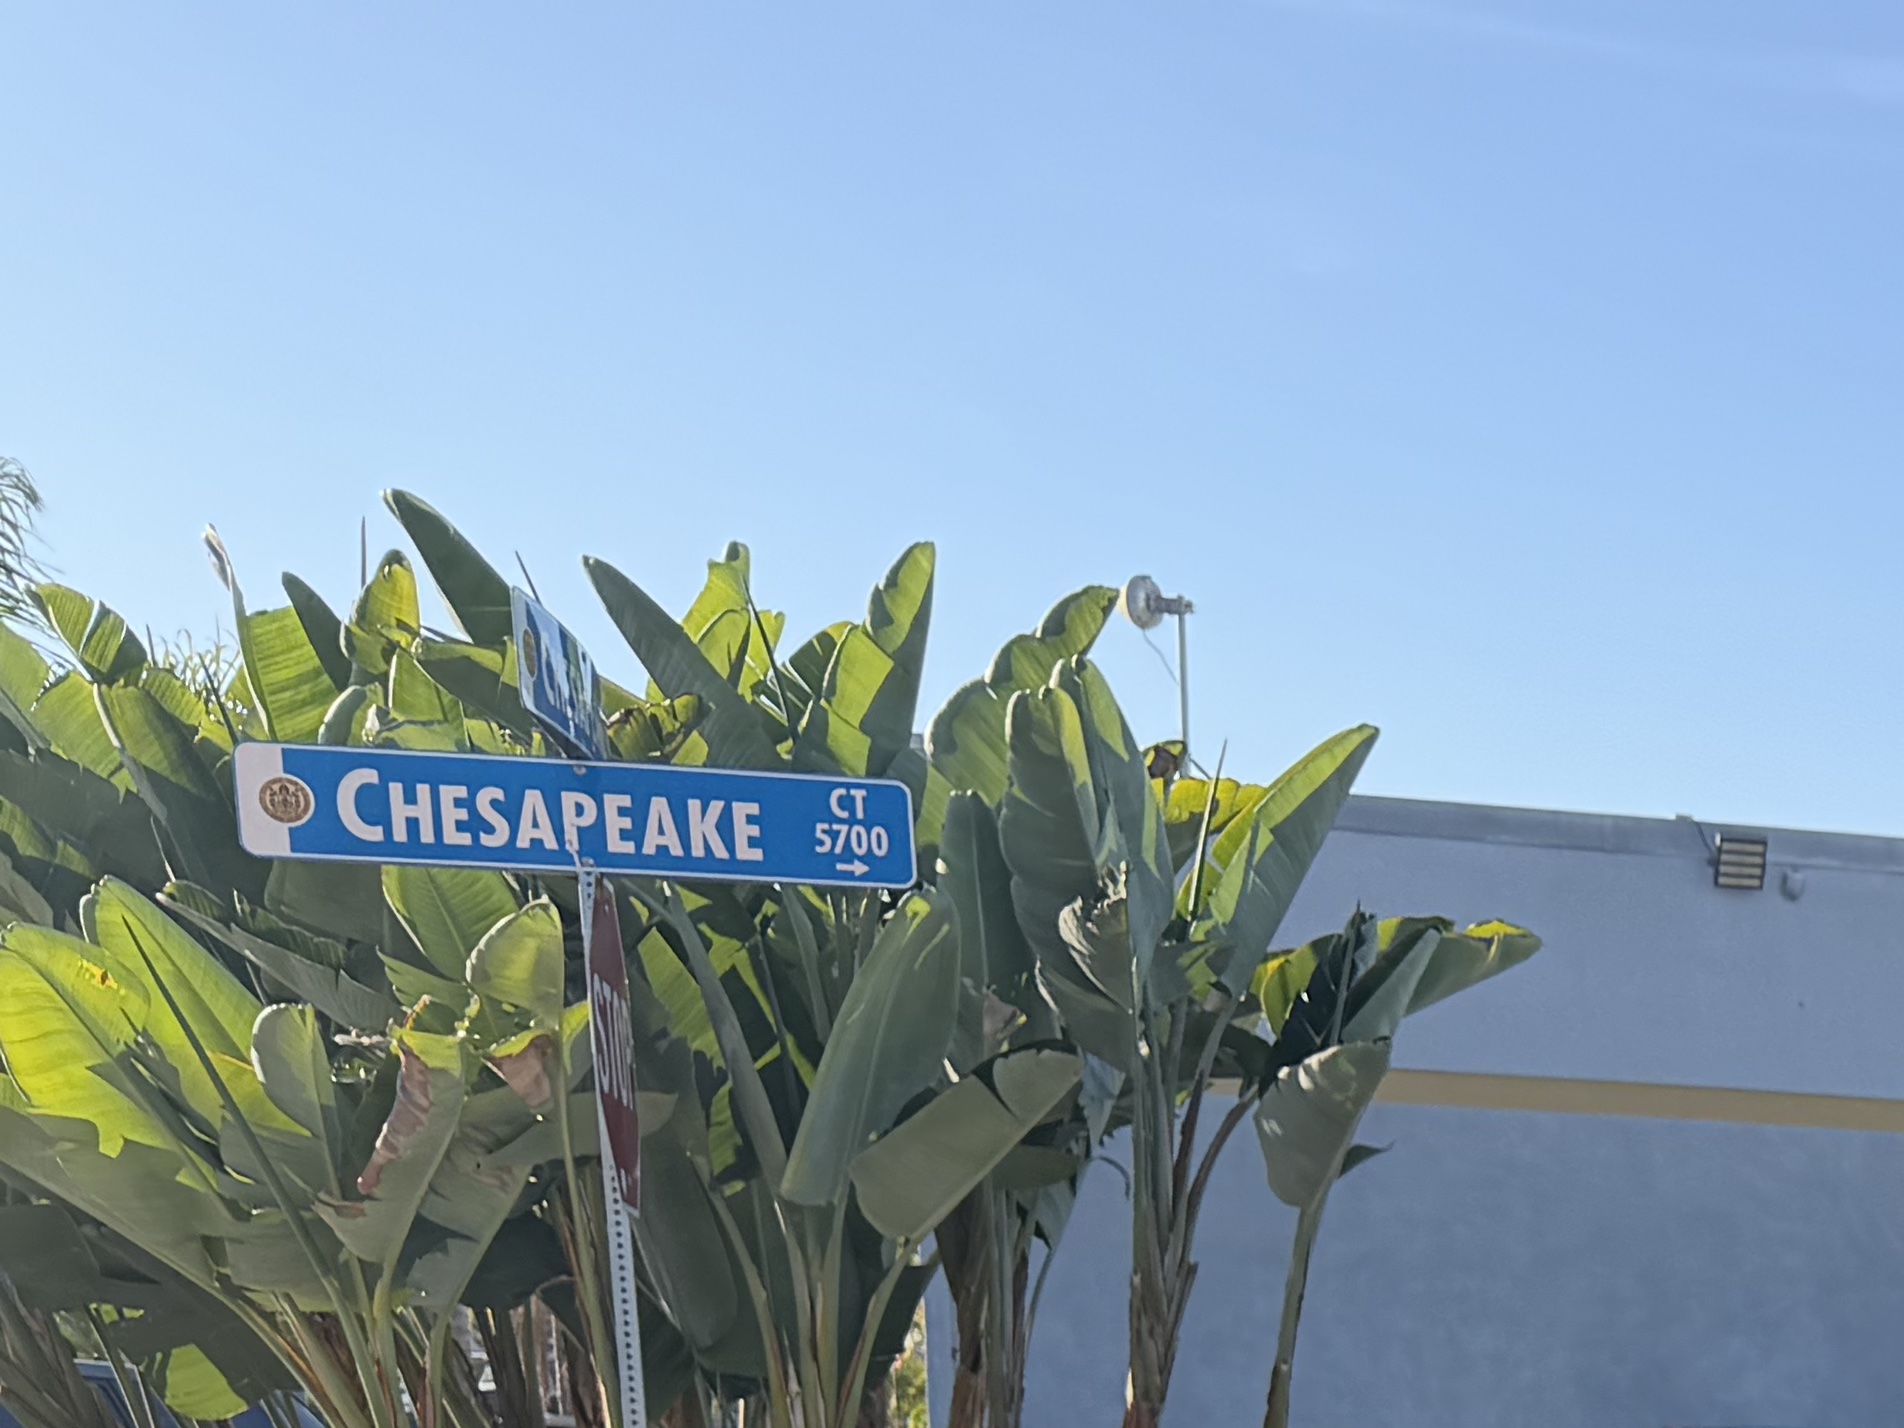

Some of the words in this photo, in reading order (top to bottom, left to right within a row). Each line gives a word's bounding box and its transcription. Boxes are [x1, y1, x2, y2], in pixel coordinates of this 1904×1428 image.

[335, 766, 765, 862] CHESAPEAKE
[828, 787, 868, 821] CT
[813, 822, 890, 859] 5700
